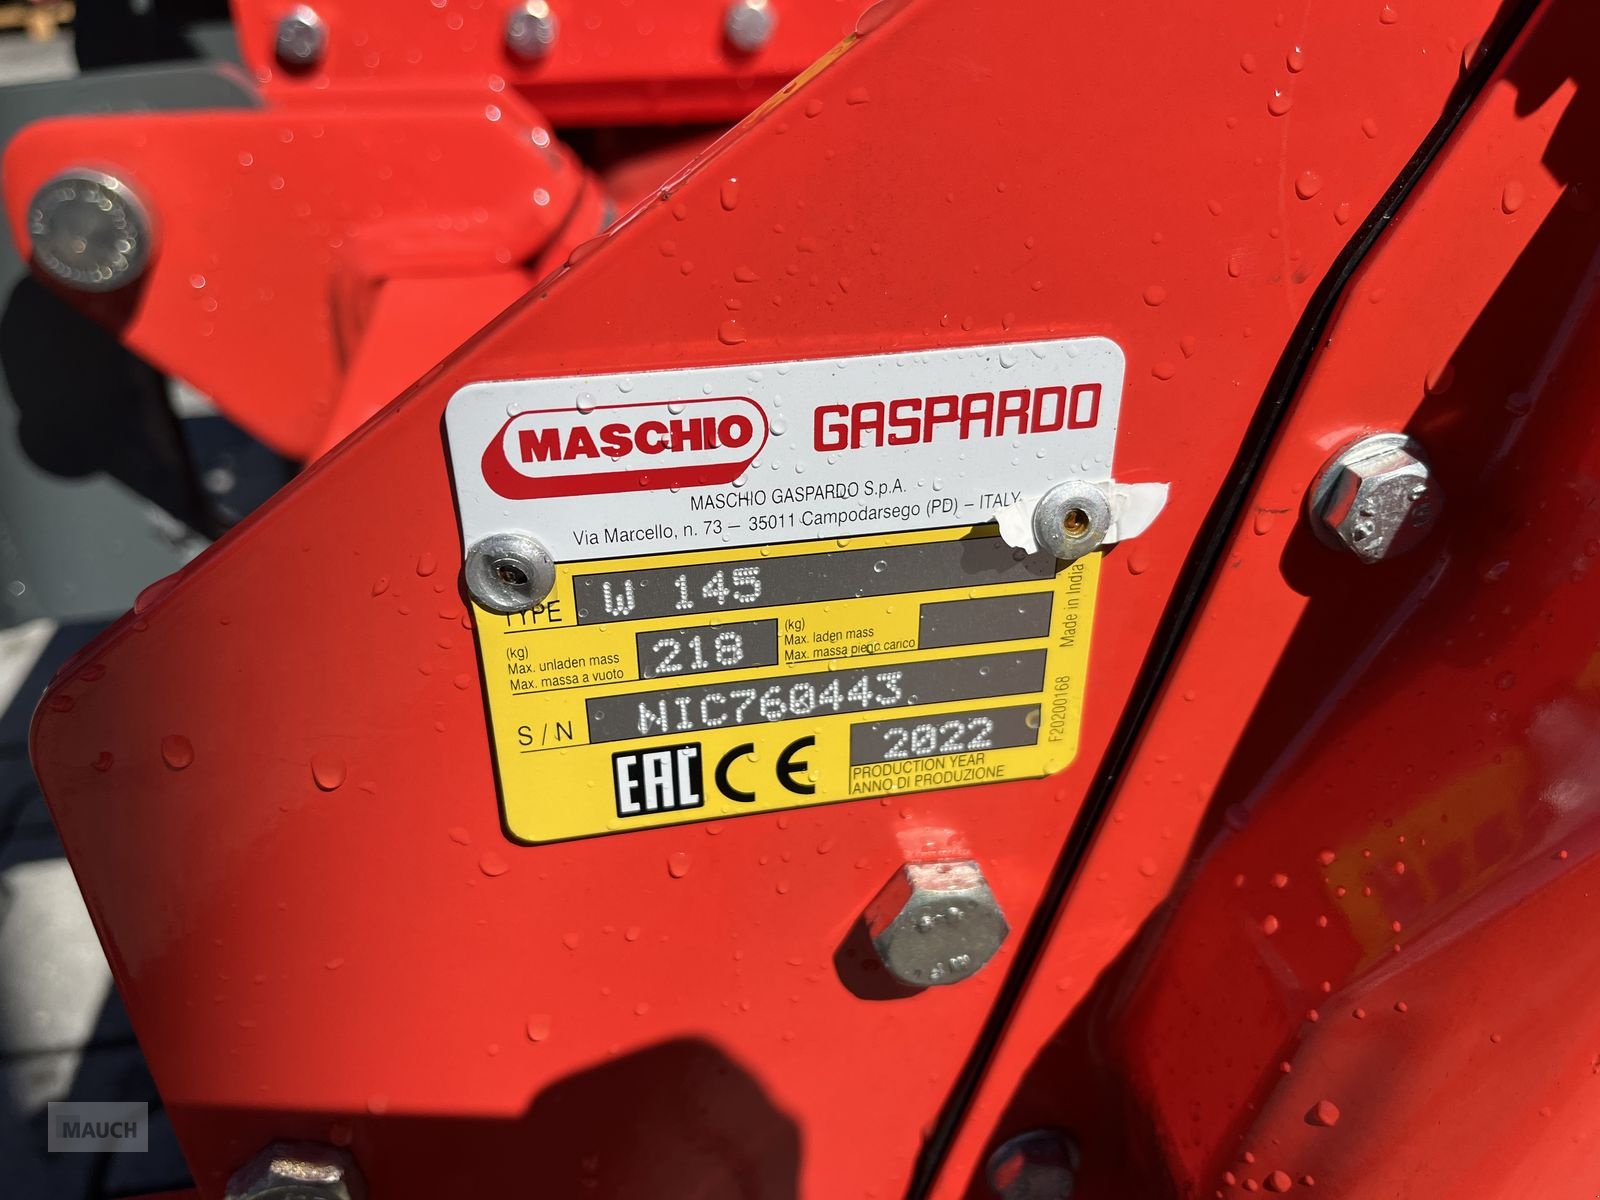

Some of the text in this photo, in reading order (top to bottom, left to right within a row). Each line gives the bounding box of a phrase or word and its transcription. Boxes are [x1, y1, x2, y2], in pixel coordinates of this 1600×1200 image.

[518, 382, 1102, 463] MASCHIO GASPARDO
[690, 478, 907, 511] MASCHIO GASPARDO S.p.A.
[573, 529, 599, 546] Via
[604, 524, 678, 544] Marcello,
[683, 524, 698, 537] n.
[703, 519, 722, 535] 73
[749, 513, 794, 531] 35011
[801, 504, 921, 527] Campodarsego
[926, 497, 958, 518] (PD)
[980, 491, 1021, 509] ITALY
[602, 566, 762, 616] W 145
[1059, 563, 1084, 648] Made in India
[784, 617, 805, 632] (kg)
[784, 628, 874, 646] Max. laden mass
[506, 646, 529, 661] (kg)
[507, 654, 620, 675] Max. unladen mass
[652, 631, 744, 673] 218
[784, 639, 916, 661] Max. massa pieno carico
[510, 669, 624, 691] Max. massa a vuoto
[1048, 675, 1070, 743] F20200168
[883, 716, 993, 759] 2022
[616, 747, 700, 813] EAC
[714, 735, 816, 803] CE
[852, 752, 985, 780] PRODUCTION YEAR
[852, 764, 1005, 795] ANNO DI PRODUZIONE
